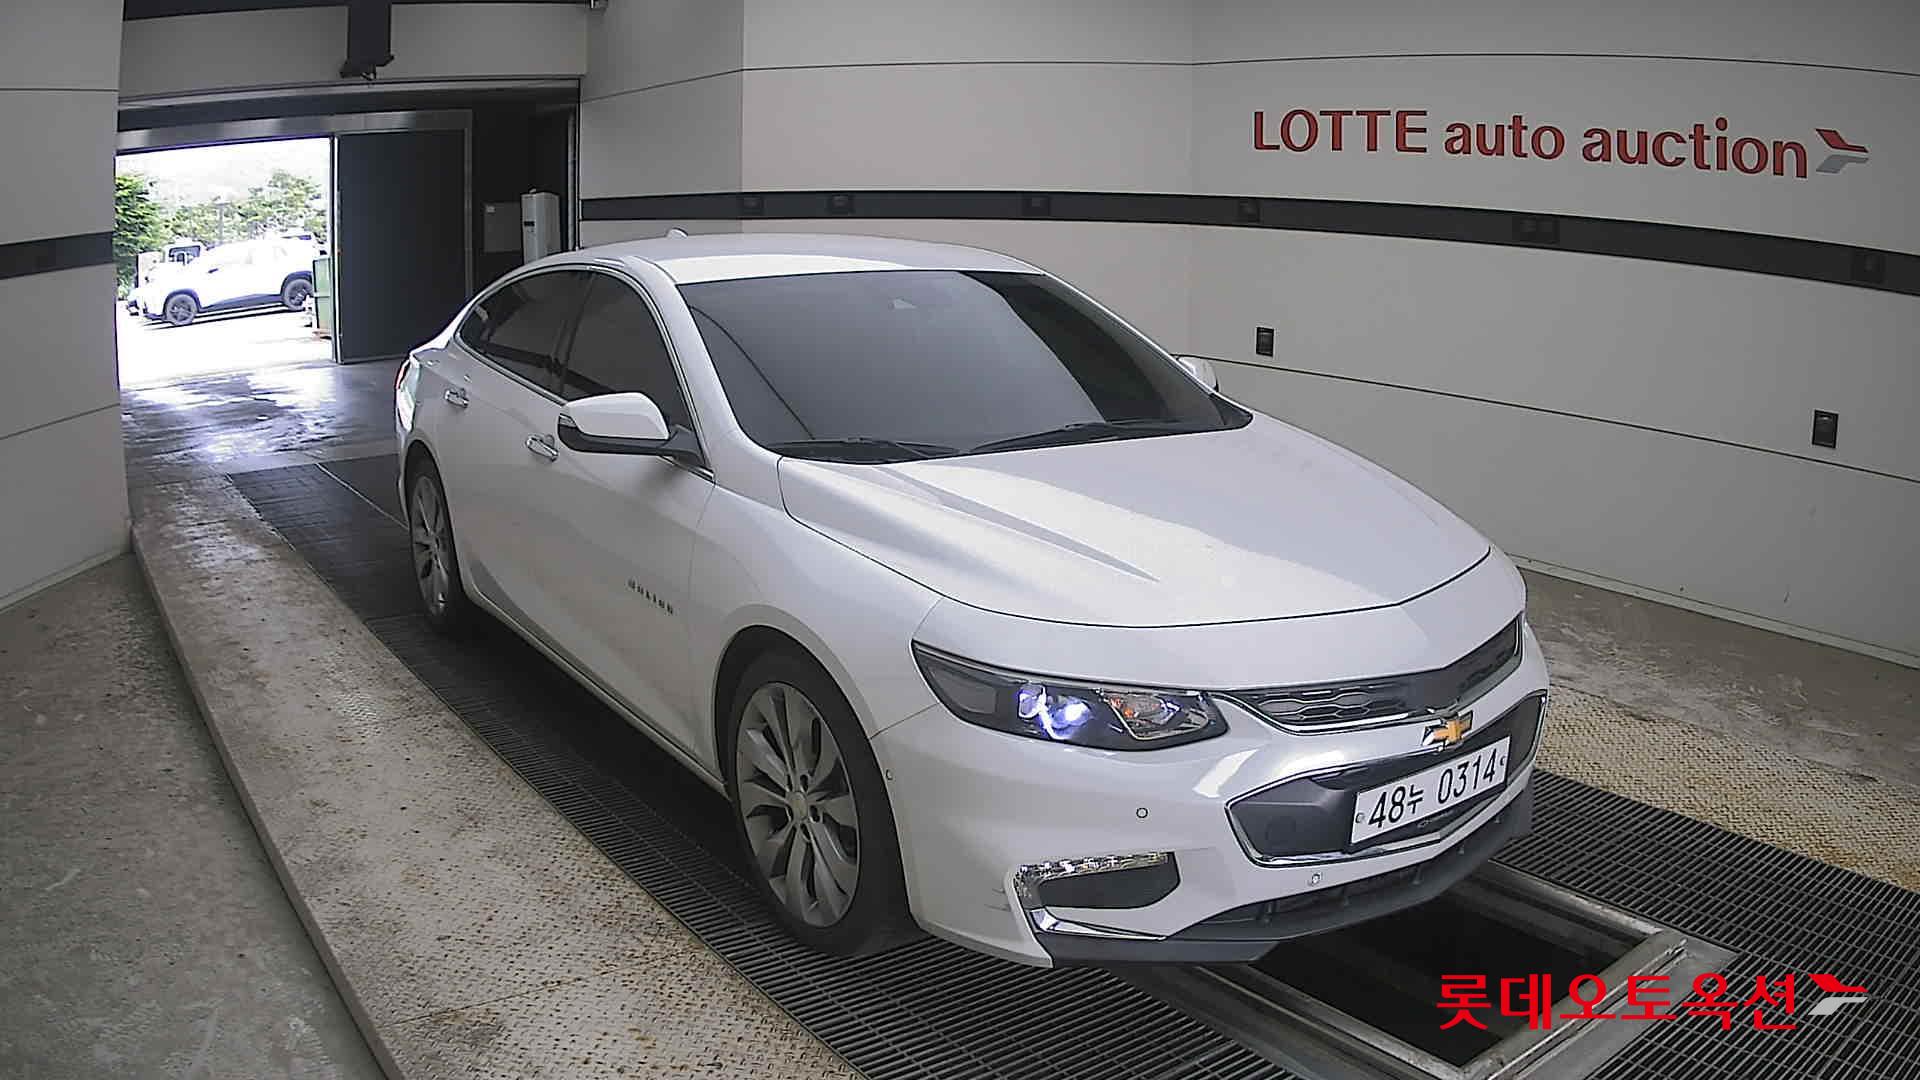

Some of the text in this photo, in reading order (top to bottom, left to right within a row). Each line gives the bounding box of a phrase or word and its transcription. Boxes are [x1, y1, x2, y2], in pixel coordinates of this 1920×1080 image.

[1253, 110, 1809, 180] LOTTE auto auction
[1368, 747, 1498, 828] 48누 0314
